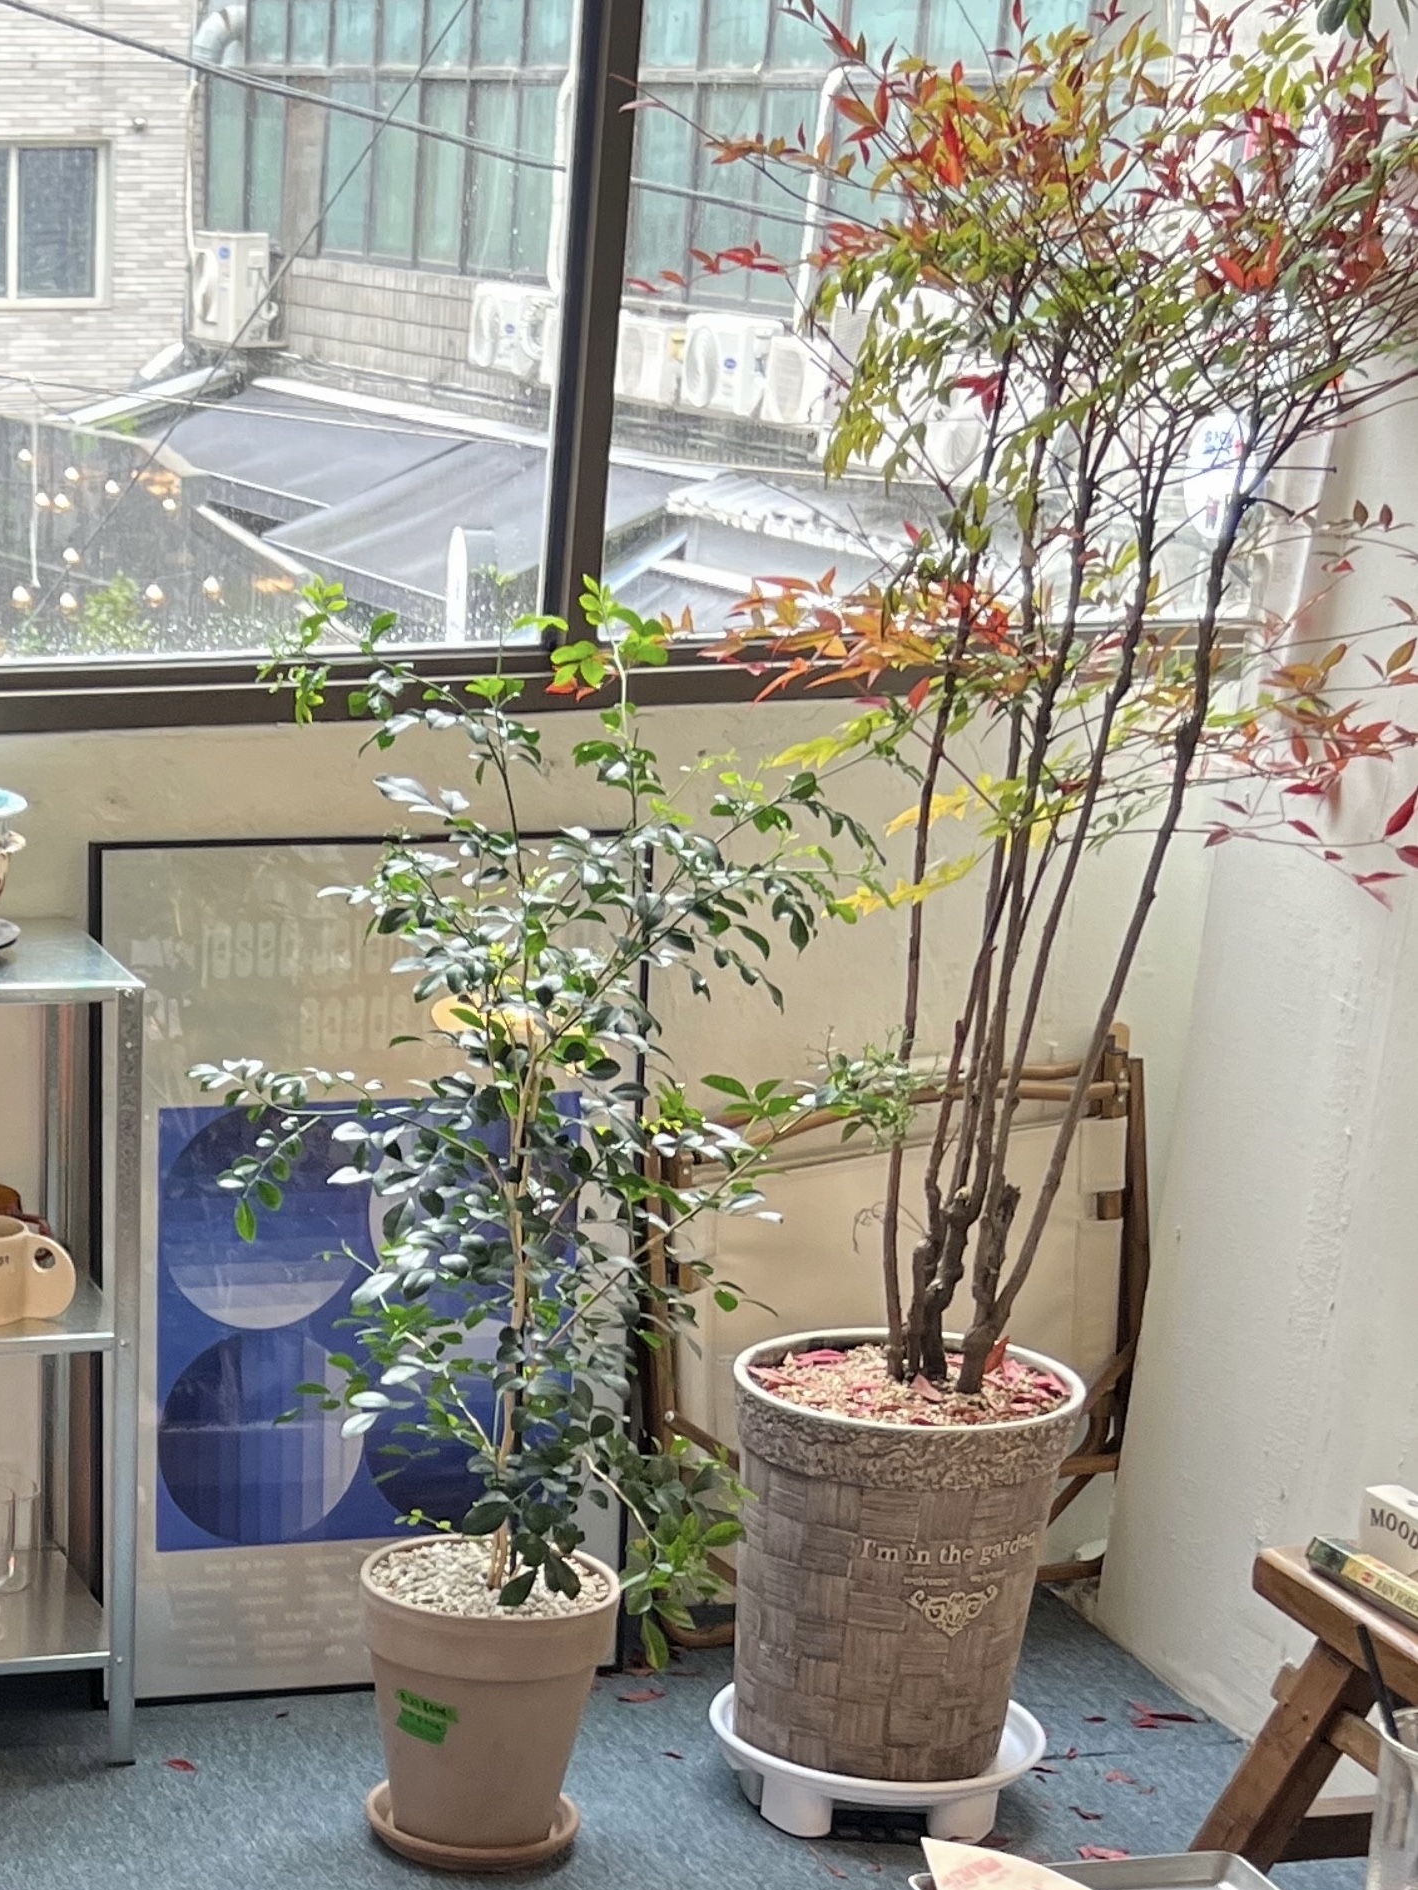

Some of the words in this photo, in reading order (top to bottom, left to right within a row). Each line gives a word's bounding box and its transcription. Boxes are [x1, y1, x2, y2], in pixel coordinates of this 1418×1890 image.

[860, 1538, 900, 1563] I'm
[906, 1544, 932, 1565] in
[939, 1544, 974, 1565] the
